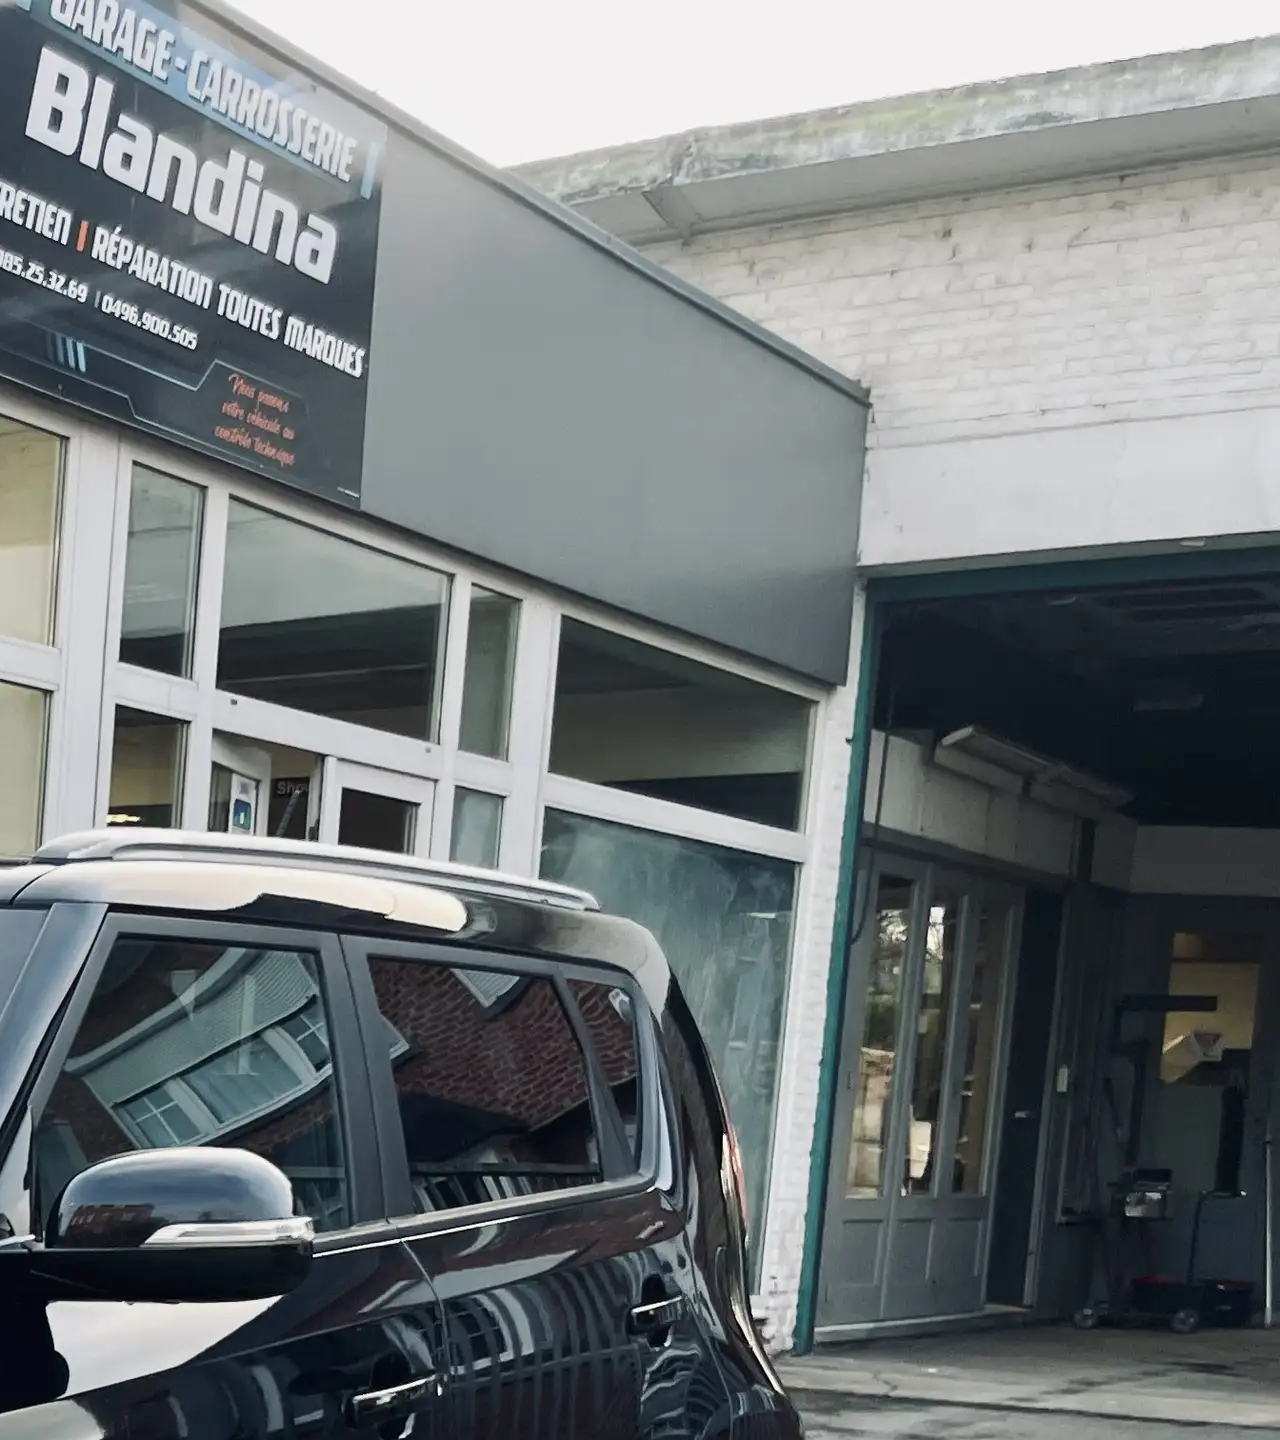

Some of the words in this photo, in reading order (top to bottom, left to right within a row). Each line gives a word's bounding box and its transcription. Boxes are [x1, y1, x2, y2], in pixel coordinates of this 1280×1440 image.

[25, 46, 341, 285] Blandina
[91, 223, 214, 309] RÉPARATION
[217, 283, 281, 340] TOUTES
[284, 316, 366, 379] MARQUES
